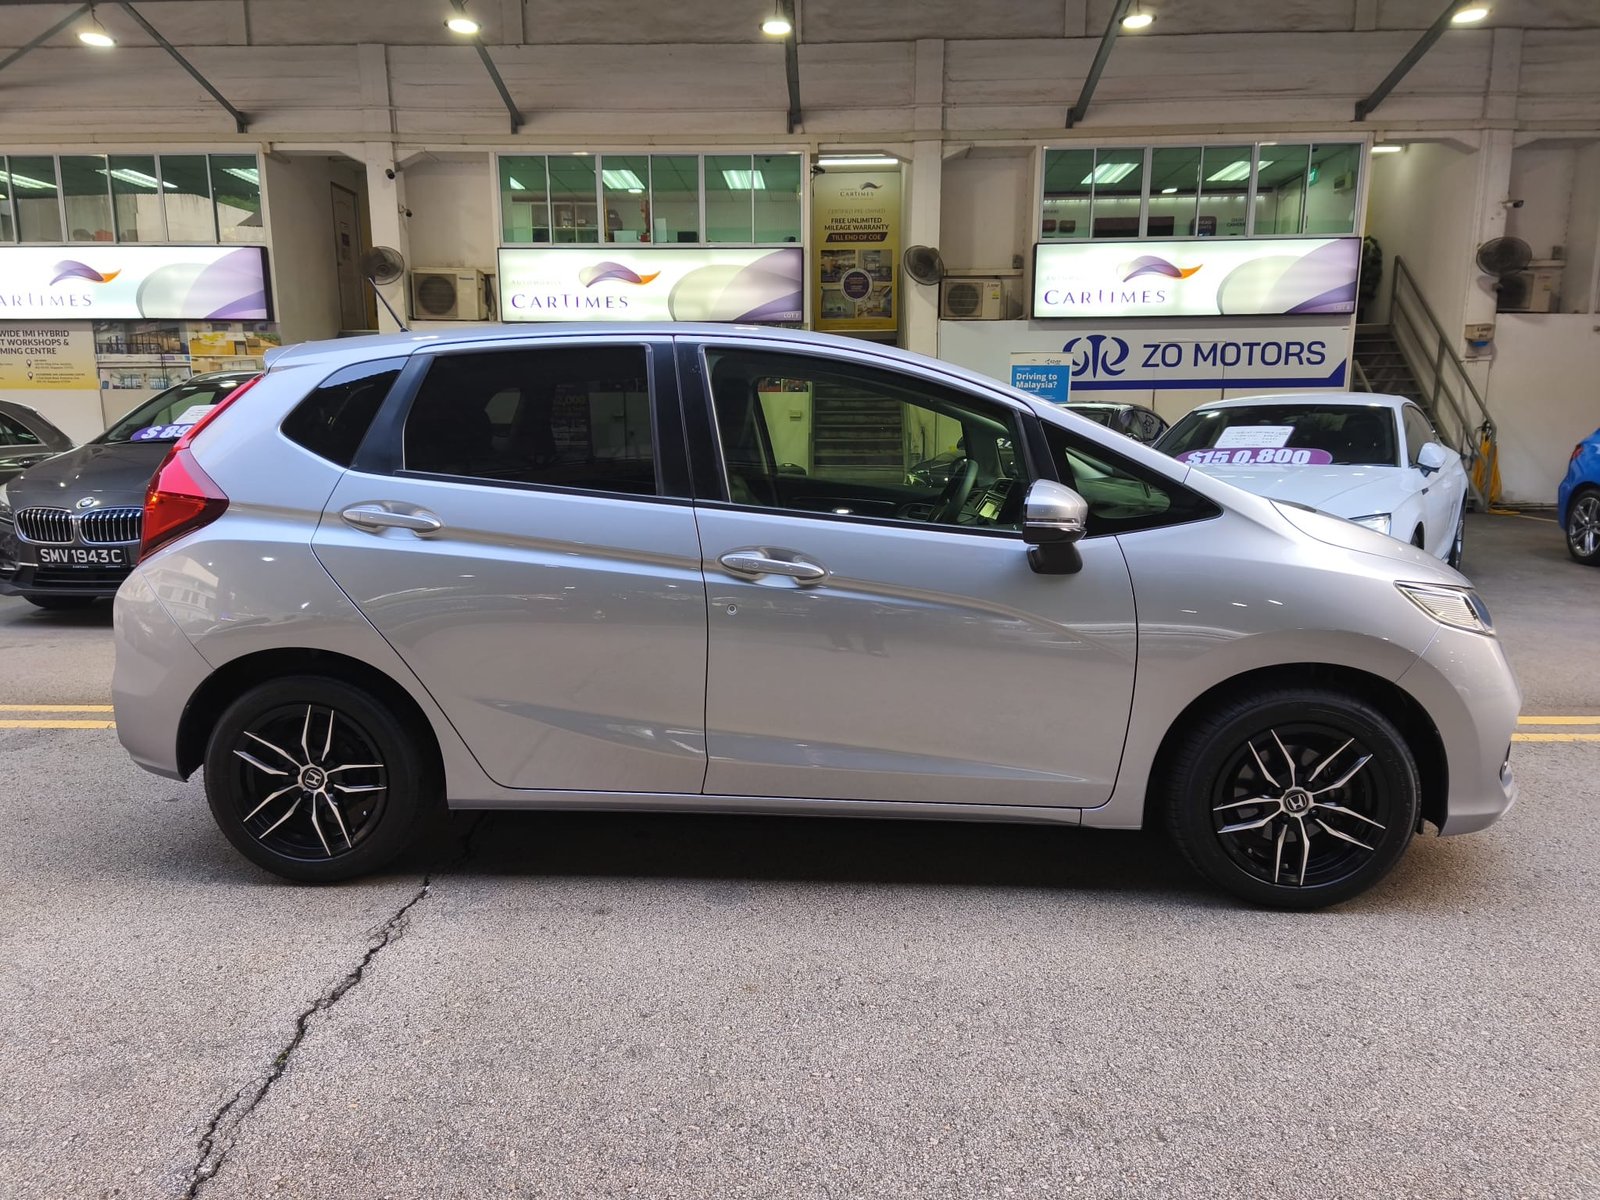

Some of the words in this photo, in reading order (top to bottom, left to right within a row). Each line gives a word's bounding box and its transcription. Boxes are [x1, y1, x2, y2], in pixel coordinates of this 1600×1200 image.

[37, 329, 70, 337] HYBRID
[6, 338, 62, 346] WORKSHOPS
[63, 338, 69, 346] &
[24, 347, 57, 355] CENTRE
[1141, 343, 1183, 368] ZO
[1193, 341, 1326, 367] MOTORS
[1016, 372, 1047, 381] Driving
[1016, 381, 1058, 389] Malaysia?
